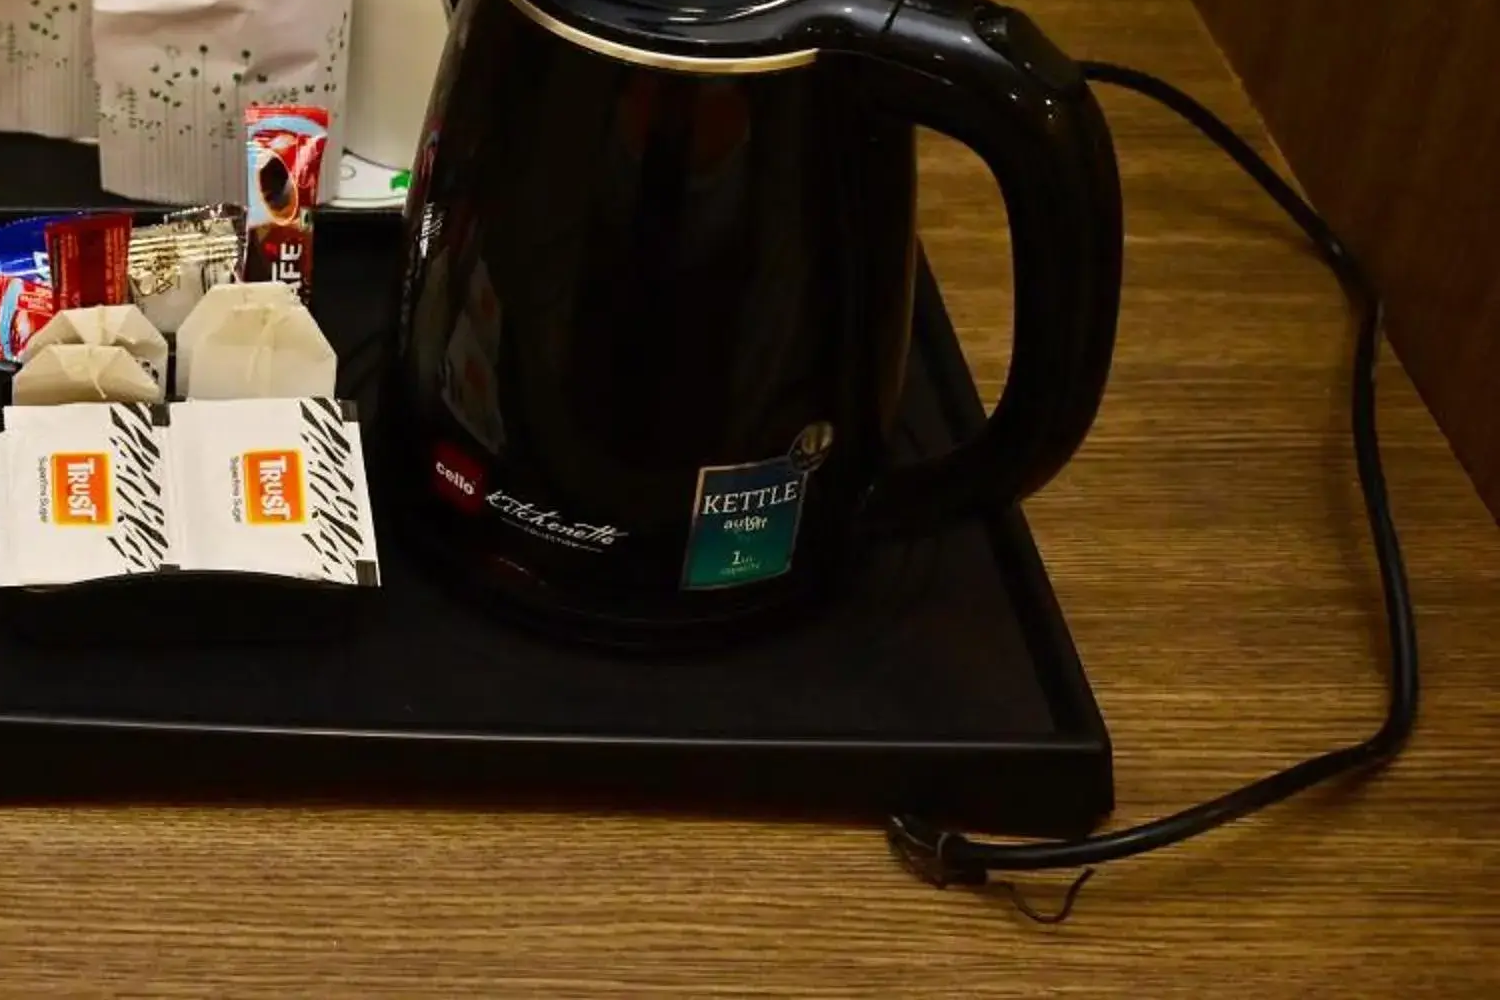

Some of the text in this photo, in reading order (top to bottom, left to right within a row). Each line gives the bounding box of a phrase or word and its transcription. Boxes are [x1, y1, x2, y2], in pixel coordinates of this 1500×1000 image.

[67, 457, 97, 521] TRUST
[260, 455, 292, 521] TRUST
[435, 460, 476, 496] cello
[701, 480, 799, 516] KETTLE
